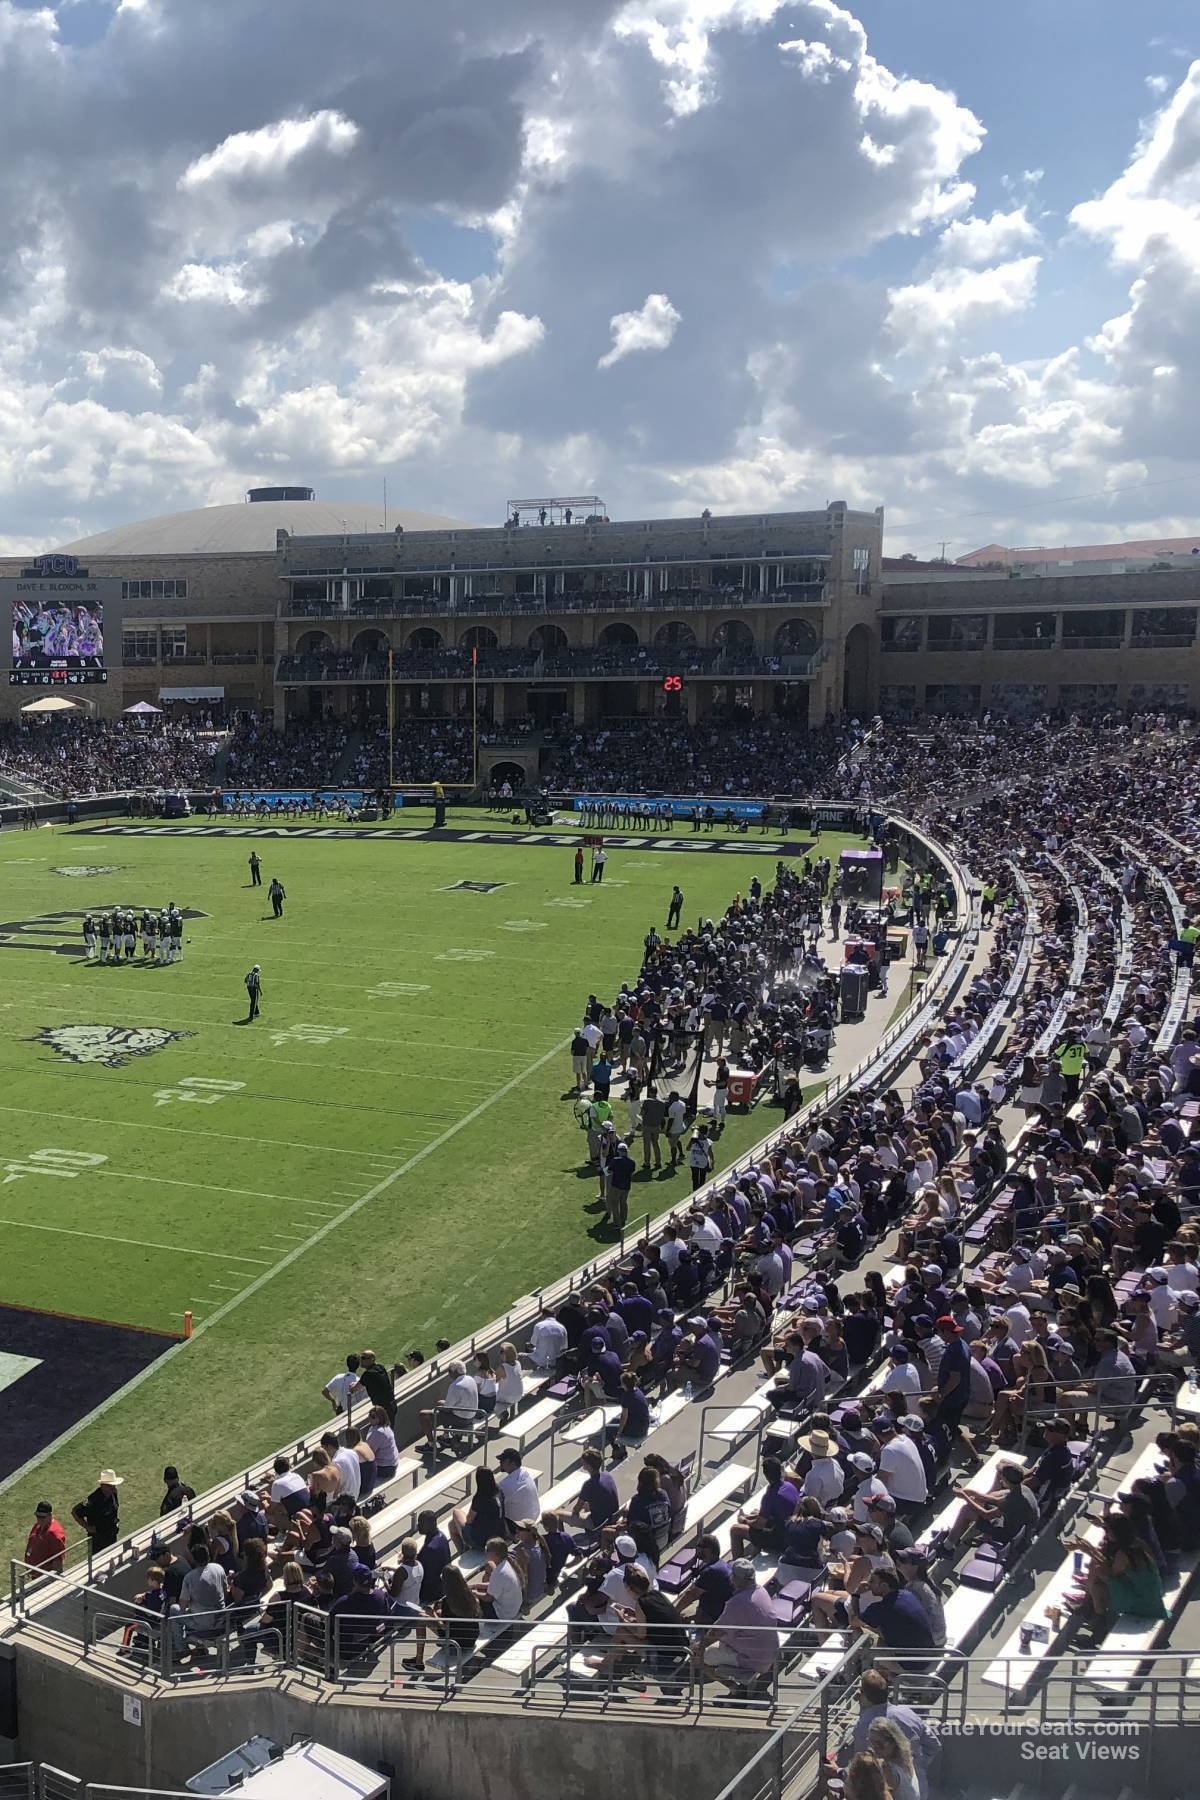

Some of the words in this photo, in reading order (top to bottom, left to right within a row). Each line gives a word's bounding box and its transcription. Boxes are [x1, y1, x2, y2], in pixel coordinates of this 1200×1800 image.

[40, 555, 79, 576] TCU
[664, 676, 682, 690] 25
[90, 825, 431, 839] HORNED
[456, 832, 785, 853] FROGS
[1070, 1047, 1082, 1058] 37
[152, 1076, 247, 1107] 20
[730, 1081, 744, 1095] G
[2, 1148, 109, 1184] 10
